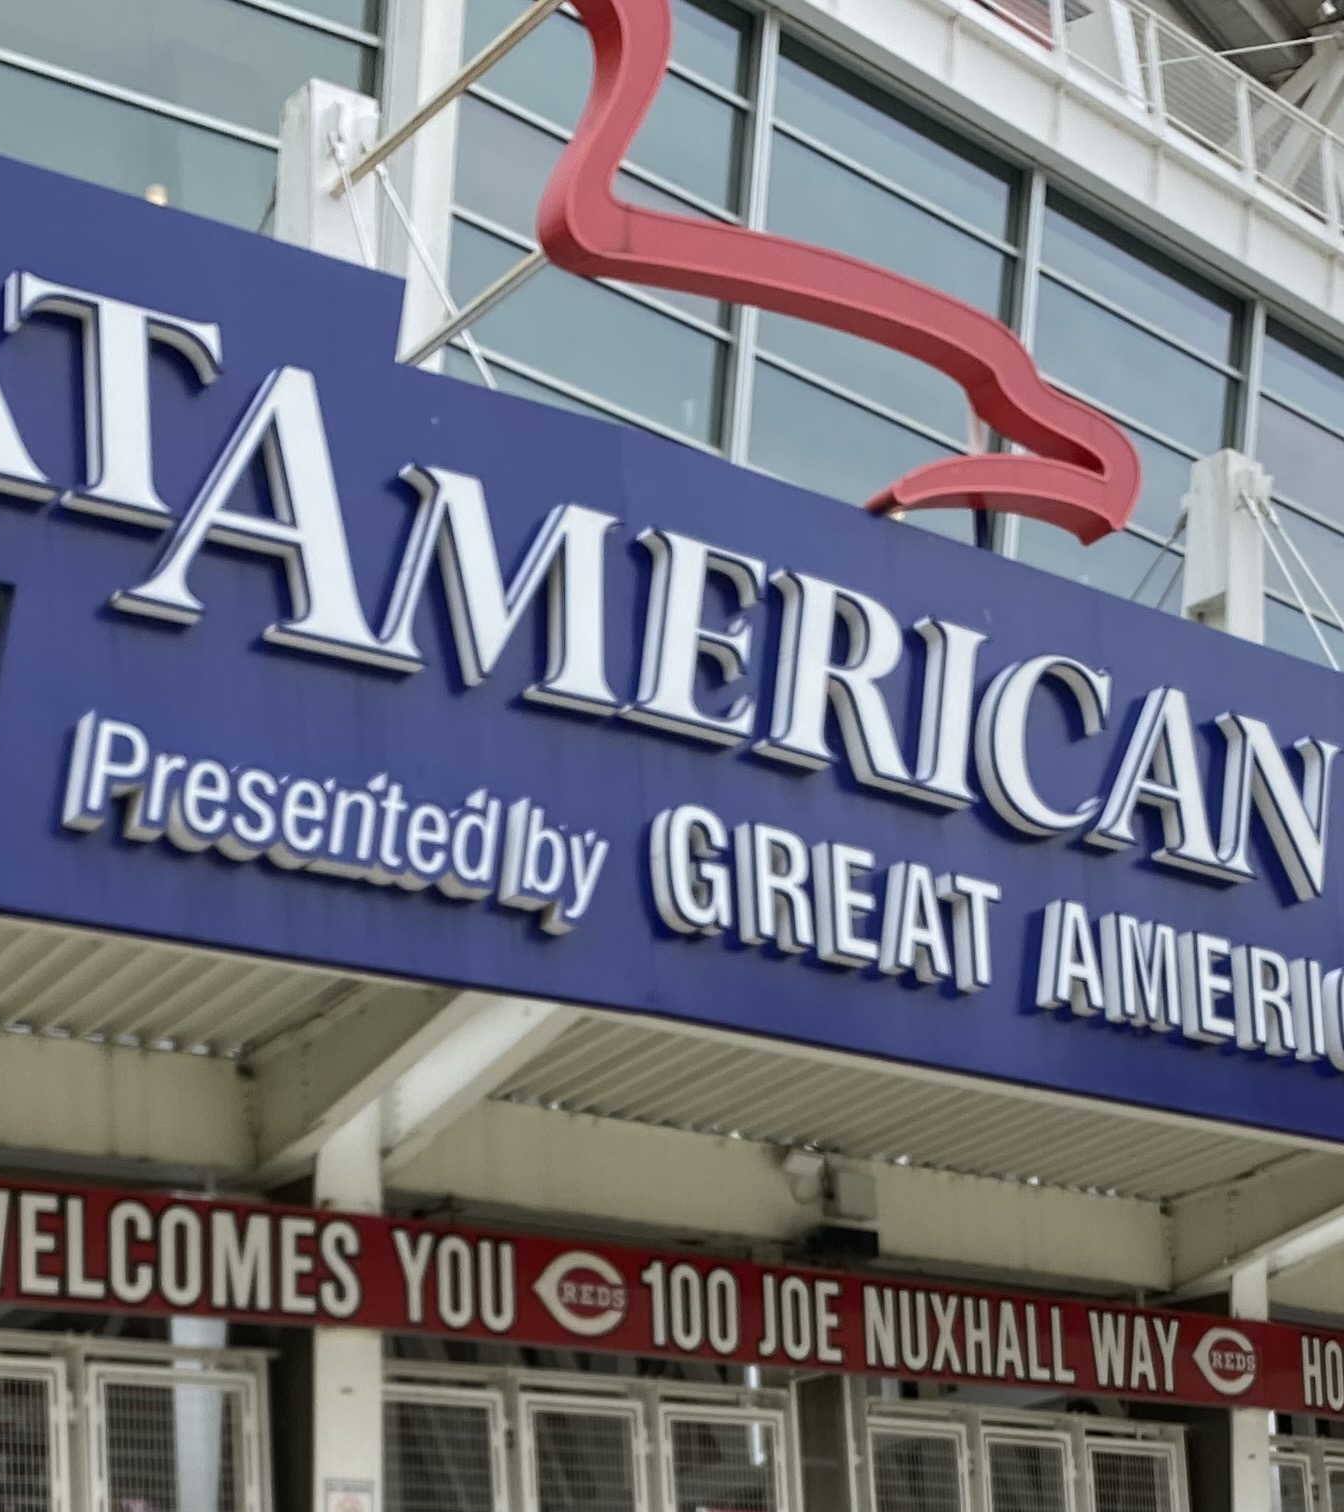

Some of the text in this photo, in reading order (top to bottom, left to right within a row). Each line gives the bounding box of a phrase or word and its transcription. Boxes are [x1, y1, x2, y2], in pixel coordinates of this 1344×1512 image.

[111, 365, 1344, 901] AMERICAN
[63, 709, 501, 903] Presented
[501, 798, 608, 937] by
[653, 805, 1001, 994] GREAT
[392, 1230, 516, 1334] YOU
[560, 1284, 627, 1310] REDS
[642, 1261, 739, 1357] 100
[760, 1273, 844, 1364] JOE
[864, 1287, 1076, 1385] NUXHALL
[1088, 1310, 1179, 1392] WAY
[1211, 1350, 1256, 1373] REDS
